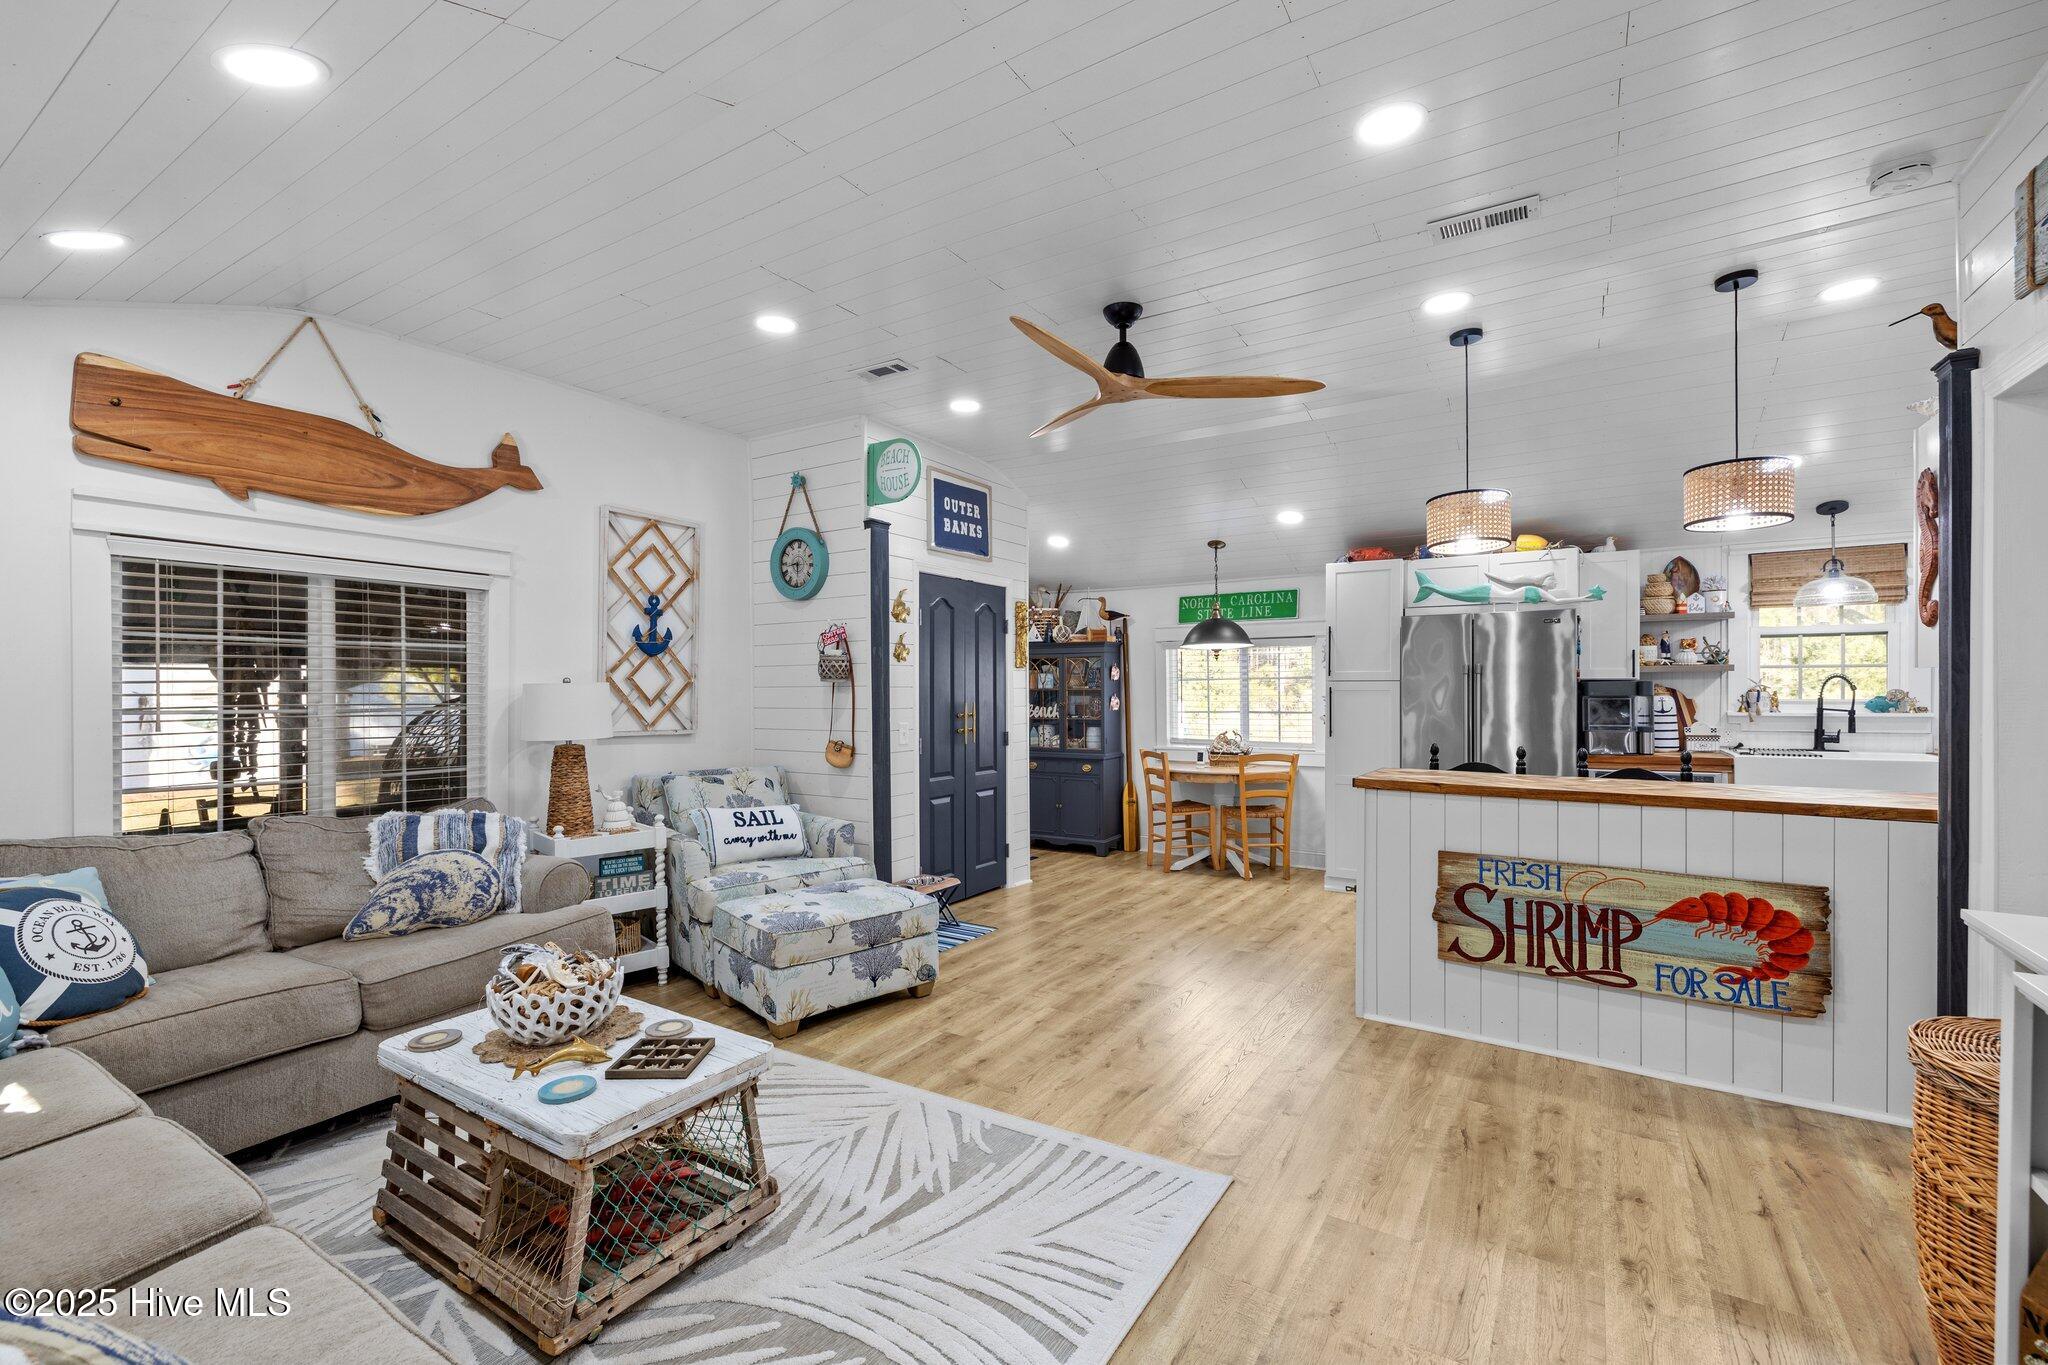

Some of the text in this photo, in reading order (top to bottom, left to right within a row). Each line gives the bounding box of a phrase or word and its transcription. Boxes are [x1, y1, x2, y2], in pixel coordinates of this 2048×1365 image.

[881, 448, 910, 467] BEACH
[881, 473, 909, 491] HOUSE
[943, 496, 980, 519] OUTER
[943, 517, 982, 539] BANKS
[1230, 592, 1293, 606] CAROLINA
[1197, 605, 1272, 620] STTE LINE
[733, 810, 783, 827] SAIL
[723, 836, 756, 848] away
[757, 829, 782, 843] with
[598, 874, 651, 890] TIME
[1477, 858, 1562, 892] FRESH
[599, 885, 651, 898] TO RELAX
[31, 909, 54, 943] OCEAN
[55, 904, 90, 915] BLUE
[1447, 882, 1643, 989] SHRIMP
[72, 951, 128, 973] EST. 1786
[1655, 963, 1793, 1012] FOR SALE
